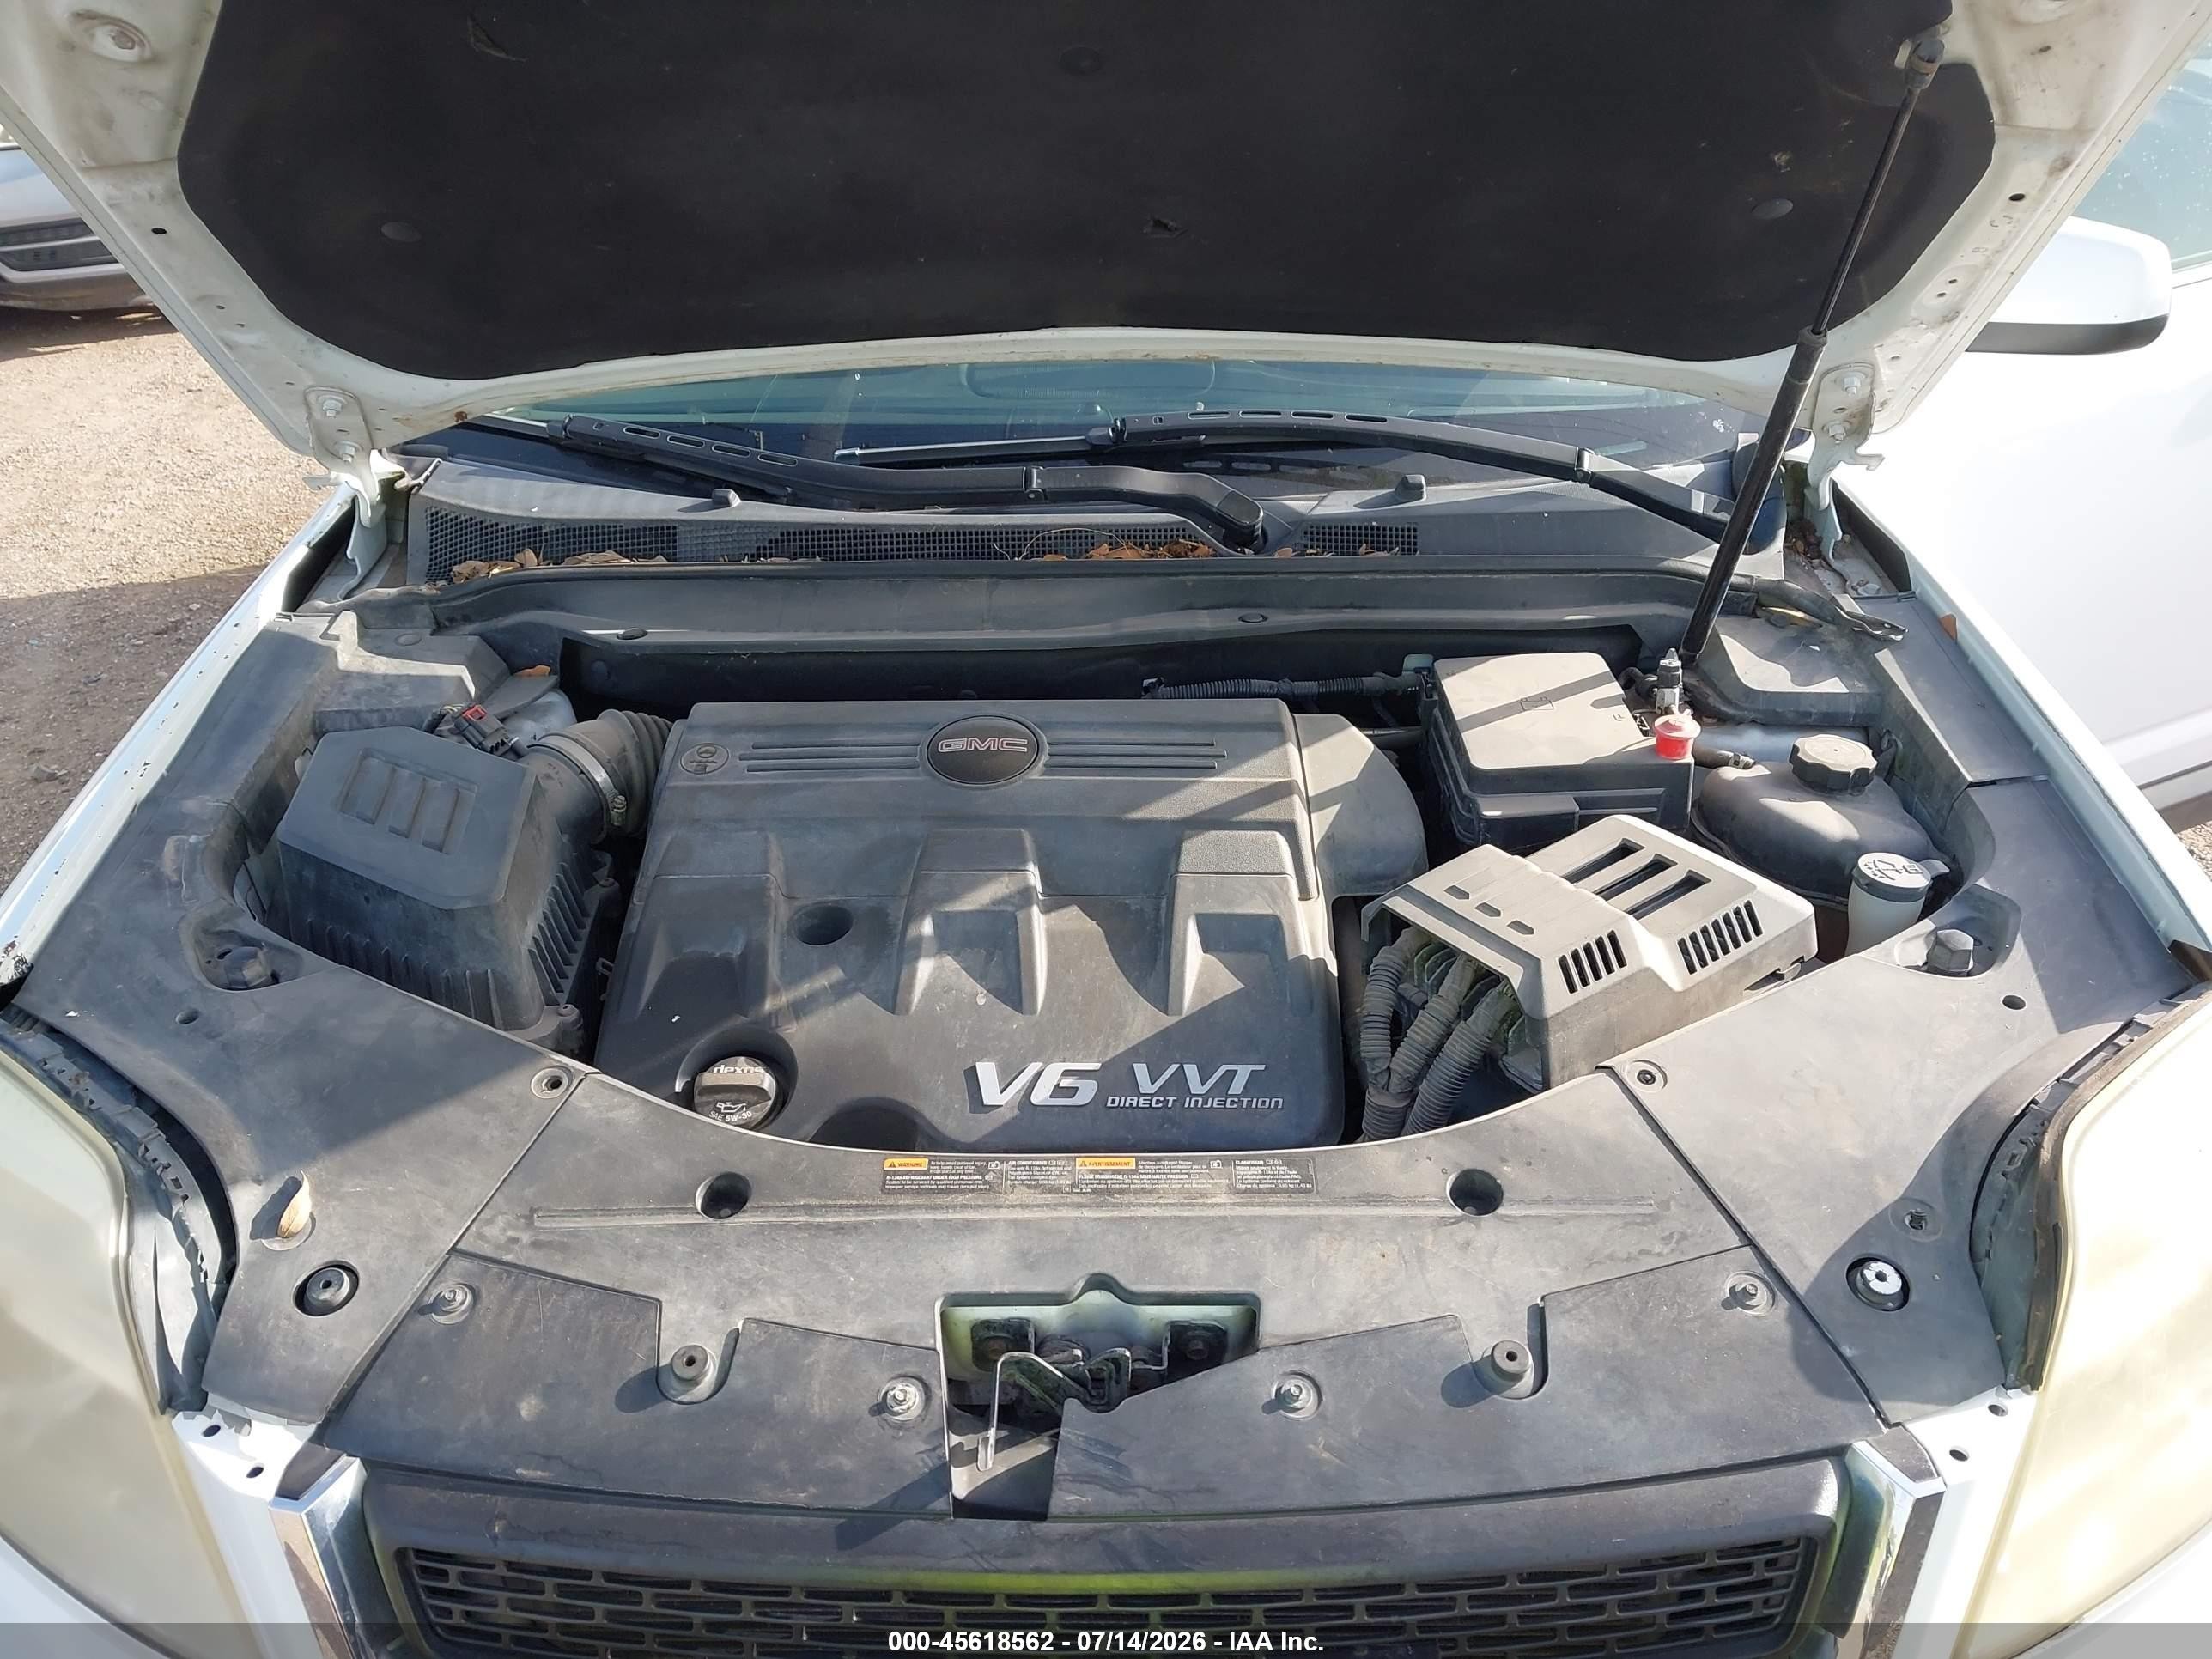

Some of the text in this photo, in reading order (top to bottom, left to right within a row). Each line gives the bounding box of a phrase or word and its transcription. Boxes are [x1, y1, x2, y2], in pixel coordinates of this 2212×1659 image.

[938, 737, 1028, 753] GMC
[975, 1061, 1266, 1106] V6 VVT
[1106, 1096, 1284, 1109] DIRECT INJECTION
[708, 1110, 753, 1122] SAE 5W-30
